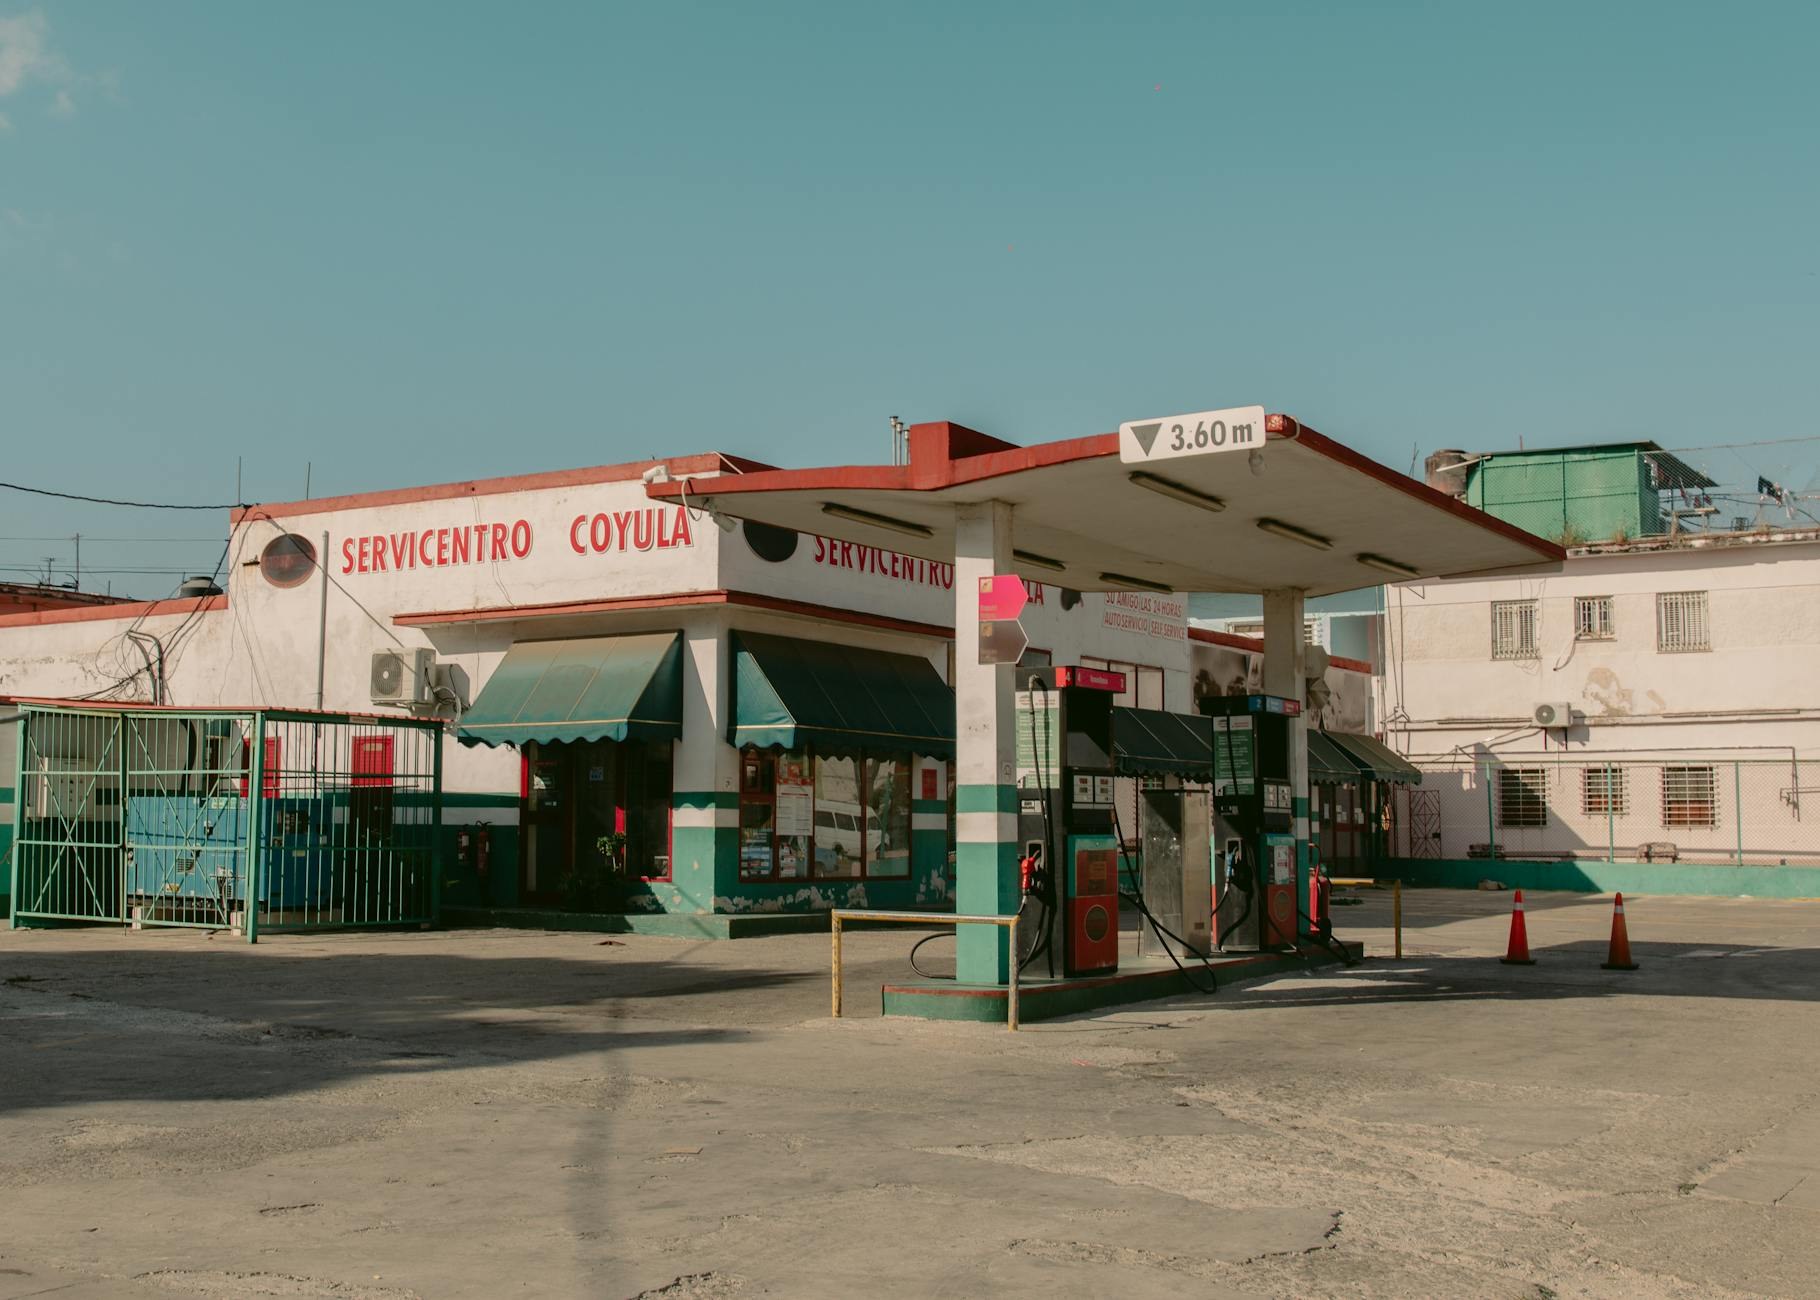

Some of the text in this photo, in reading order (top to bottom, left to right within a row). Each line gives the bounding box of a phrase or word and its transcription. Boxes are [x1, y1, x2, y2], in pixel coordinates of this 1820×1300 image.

[1170, 420, 1253, 451] 3.60 m
[341, 506, 693, 575] SERVICENTRO COYULA
[1116, 592, 1139, 610] AMIGO
[1140, 597, 1152, 612] LAS
[1161, 601, 1182, 618] HORAS
